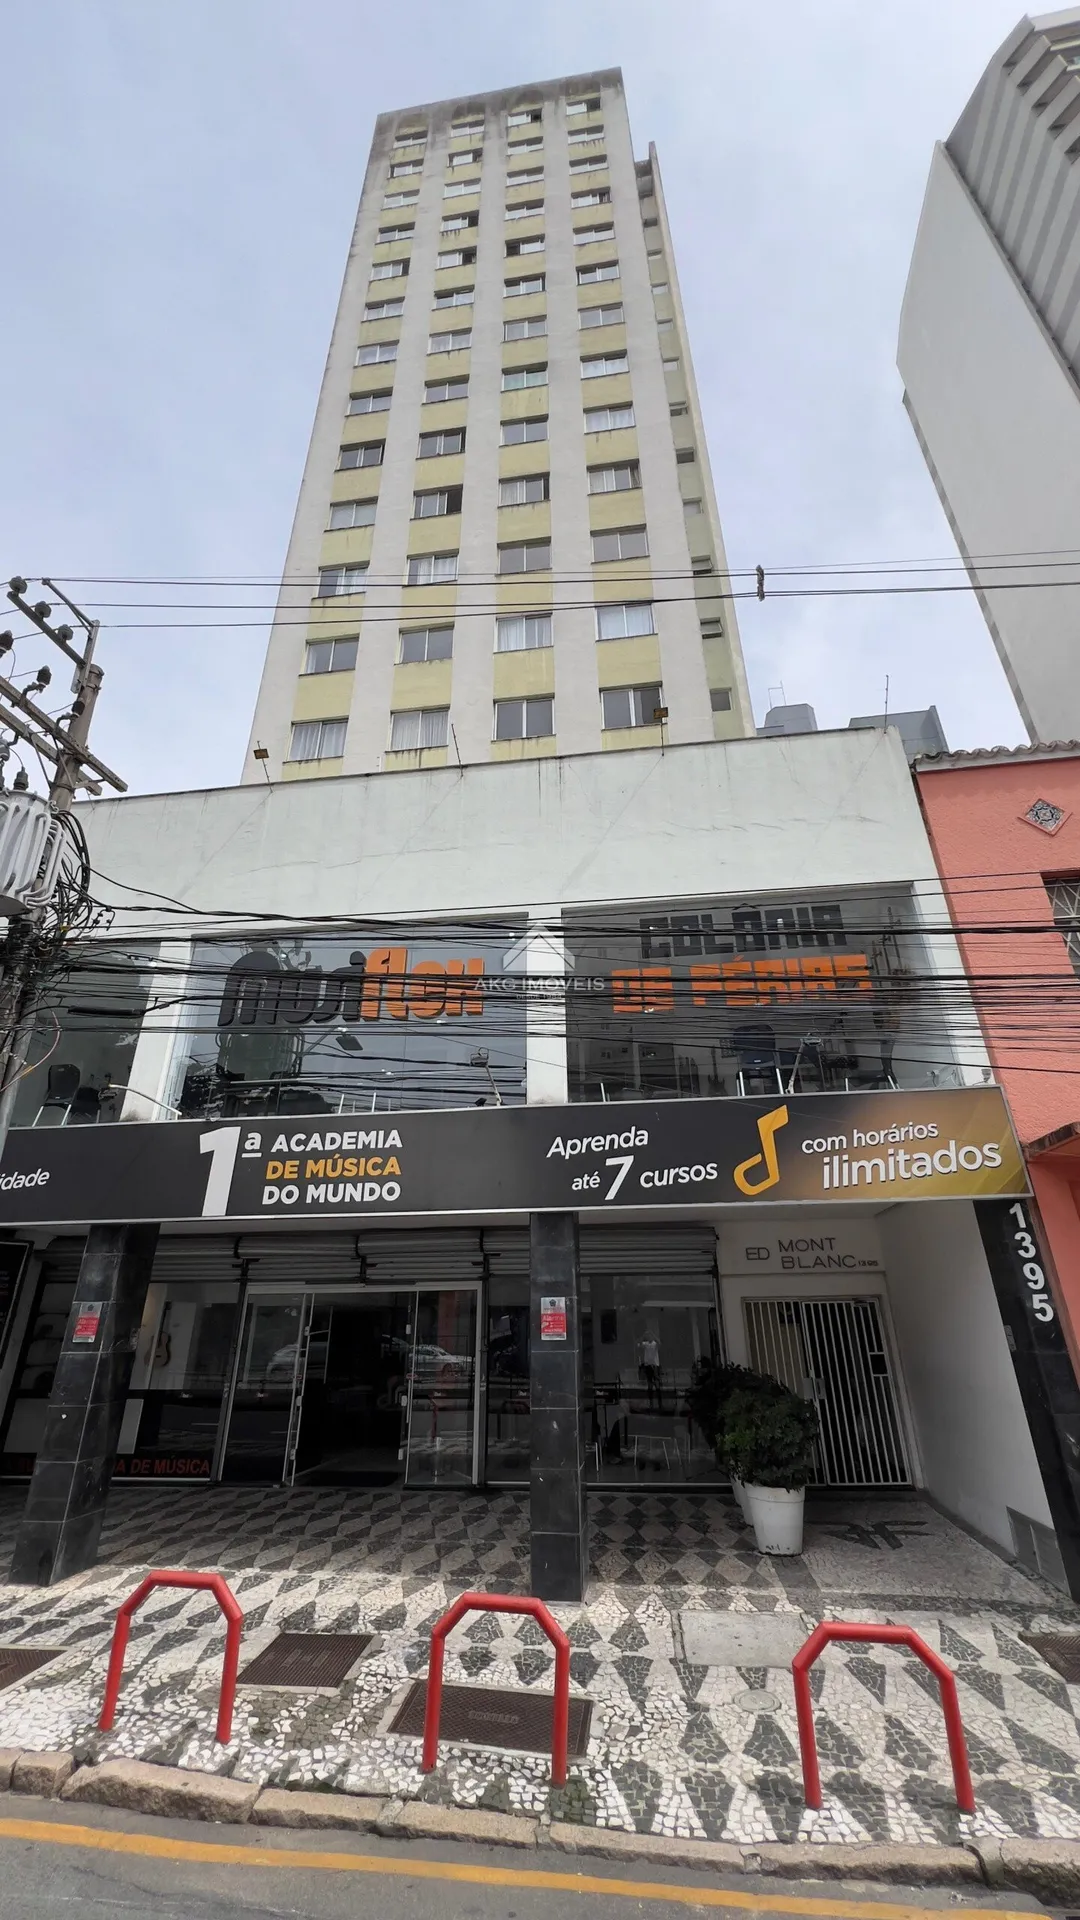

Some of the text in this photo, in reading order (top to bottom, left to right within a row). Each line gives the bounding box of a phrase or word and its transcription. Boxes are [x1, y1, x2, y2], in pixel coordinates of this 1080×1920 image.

[612, 954, 874, 1013] DE FÉRIAS
[271, 1129, 402, 1153] ACADEMIA
[546, 1126, 649, 1160] Aprenda
[801, 1121, 939, 1155] com horários
[266, 1154, 402, 1180] DE MÚSICA
[823, 1139, 1002, 1190] ilimitados
[571, 1155, 719, 1201] até 7 cursos
[262, 1181, 401, 1205] DO MUNDO
[745, 1246, 770, 1261] ED
[778, 1237, 836, 1253] MONT
[780, 1254, 856, 1269] BLANC
[1009, 1202, 1055, 1322] 1395
[129, 1458, 152, 1475] DE
[153, 1454, 211, 1475] MÚSICA
